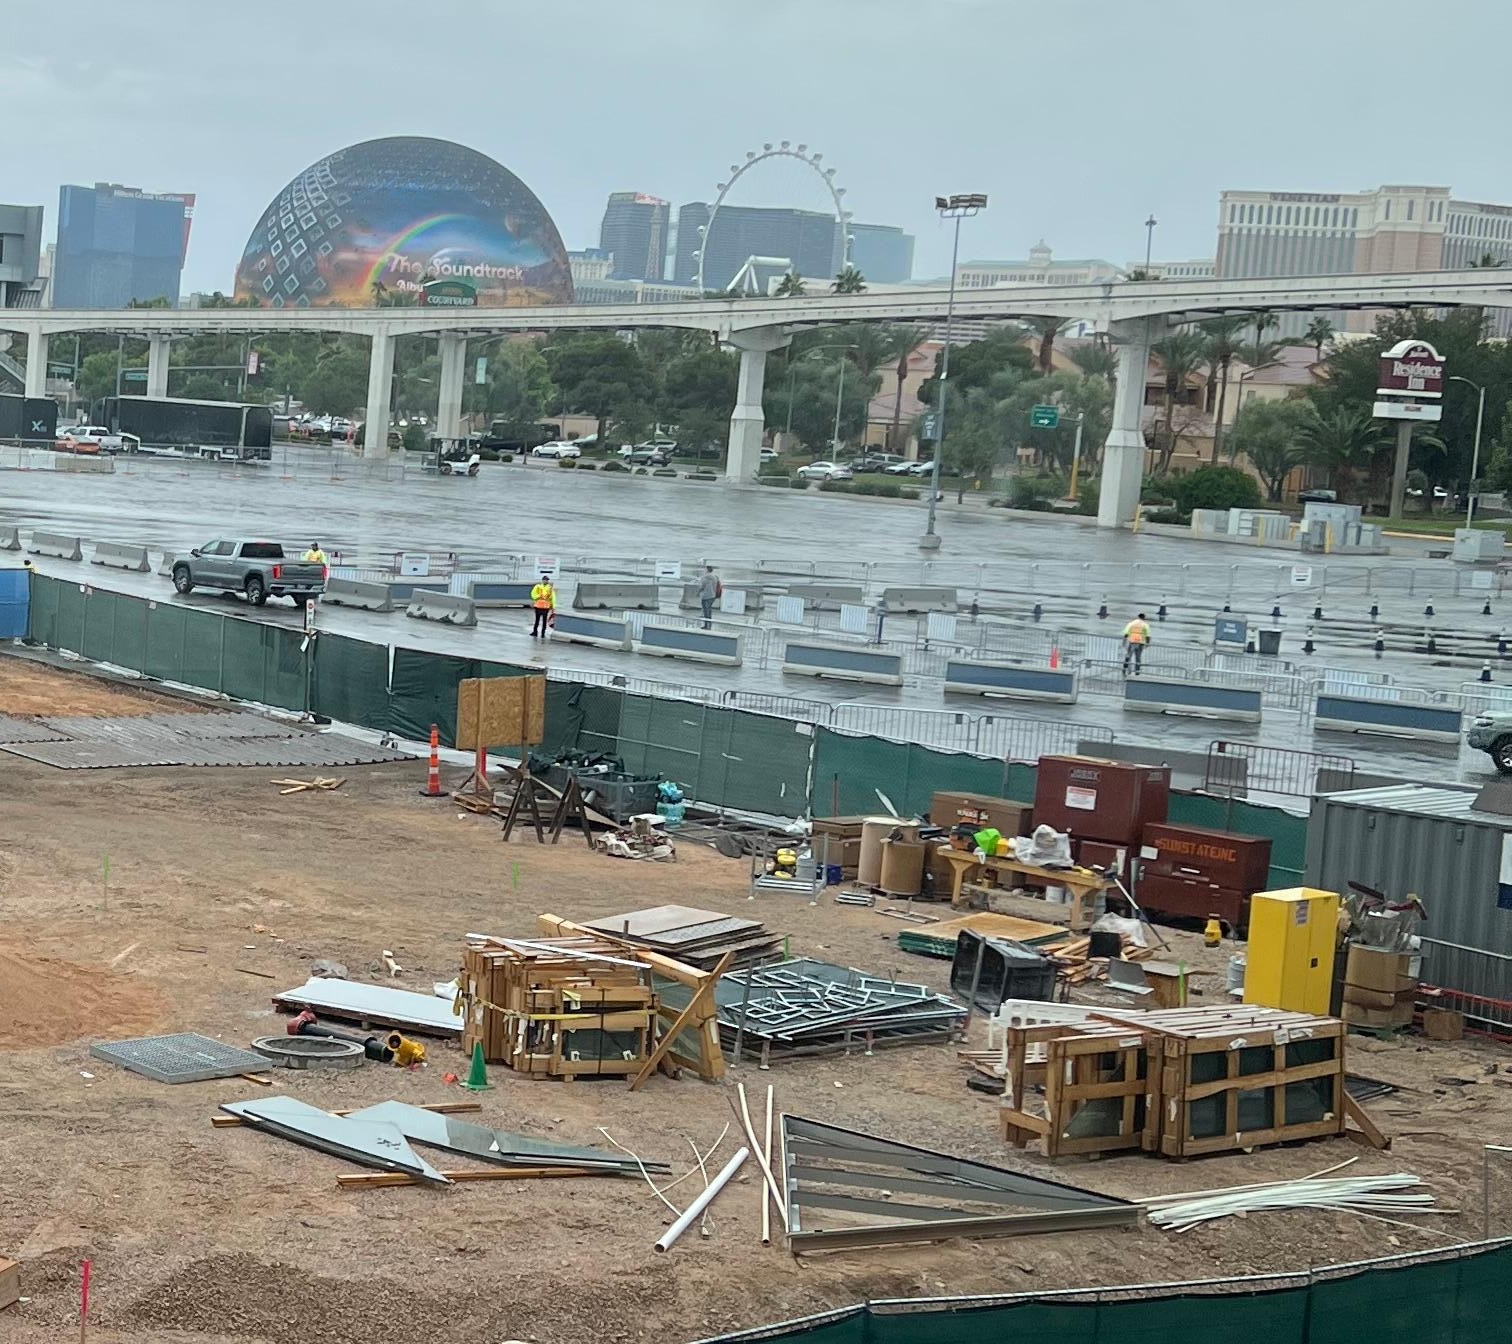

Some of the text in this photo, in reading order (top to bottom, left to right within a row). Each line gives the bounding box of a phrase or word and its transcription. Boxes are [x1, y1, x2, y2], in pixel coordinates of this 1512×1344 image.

[388, 253, 524, 280] The Soundtrack
[396, 280, 424, 292] Albu
[1392, 361, 1443, 379] Residence
